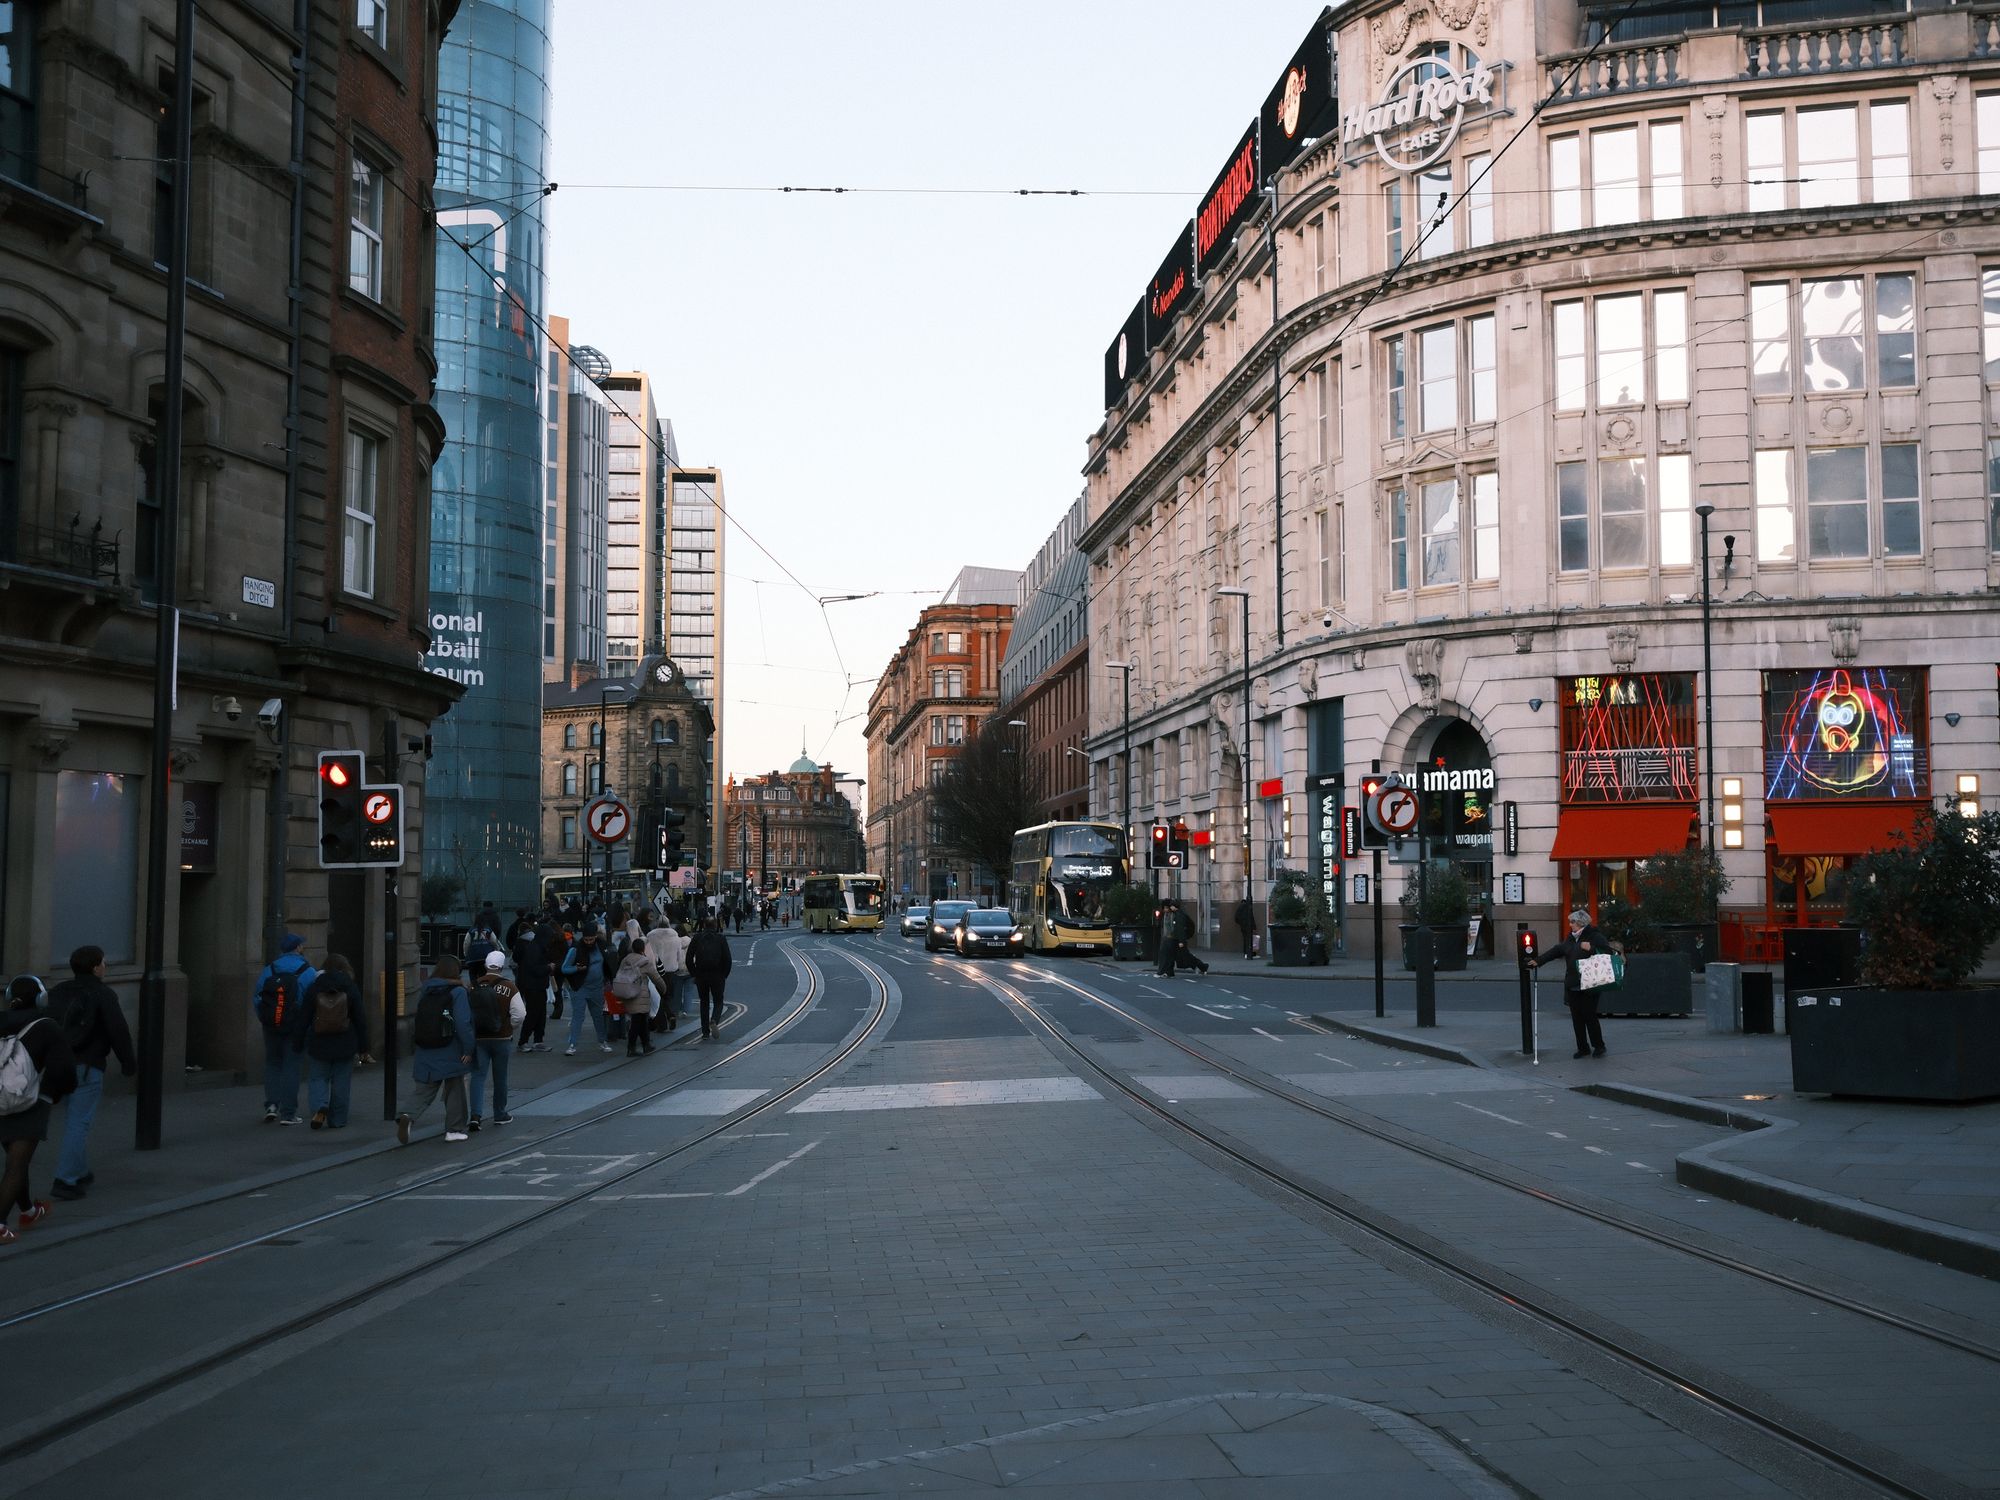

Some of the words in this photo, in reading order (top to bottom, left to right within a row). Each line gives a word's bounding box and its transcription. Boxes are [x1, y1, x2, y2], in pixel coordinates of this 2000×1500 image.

[1343, 83, 1420, 143] Hard
[1419, 59, 1495, 121] Rock
[1400, 128, 1441, 153] CAFE
[1199, 138, 1254, 262] PRINTWORKS
[244, 579, 274, 595] HANGING
[249, 591, 269, 605] DITCH
[1345, 811, 1354, 855] wagamama
[1508, 805, 1516, 852] wagamama
[1099, 866, 1113, 876] 135
[657, 896, 669, 905] 15
